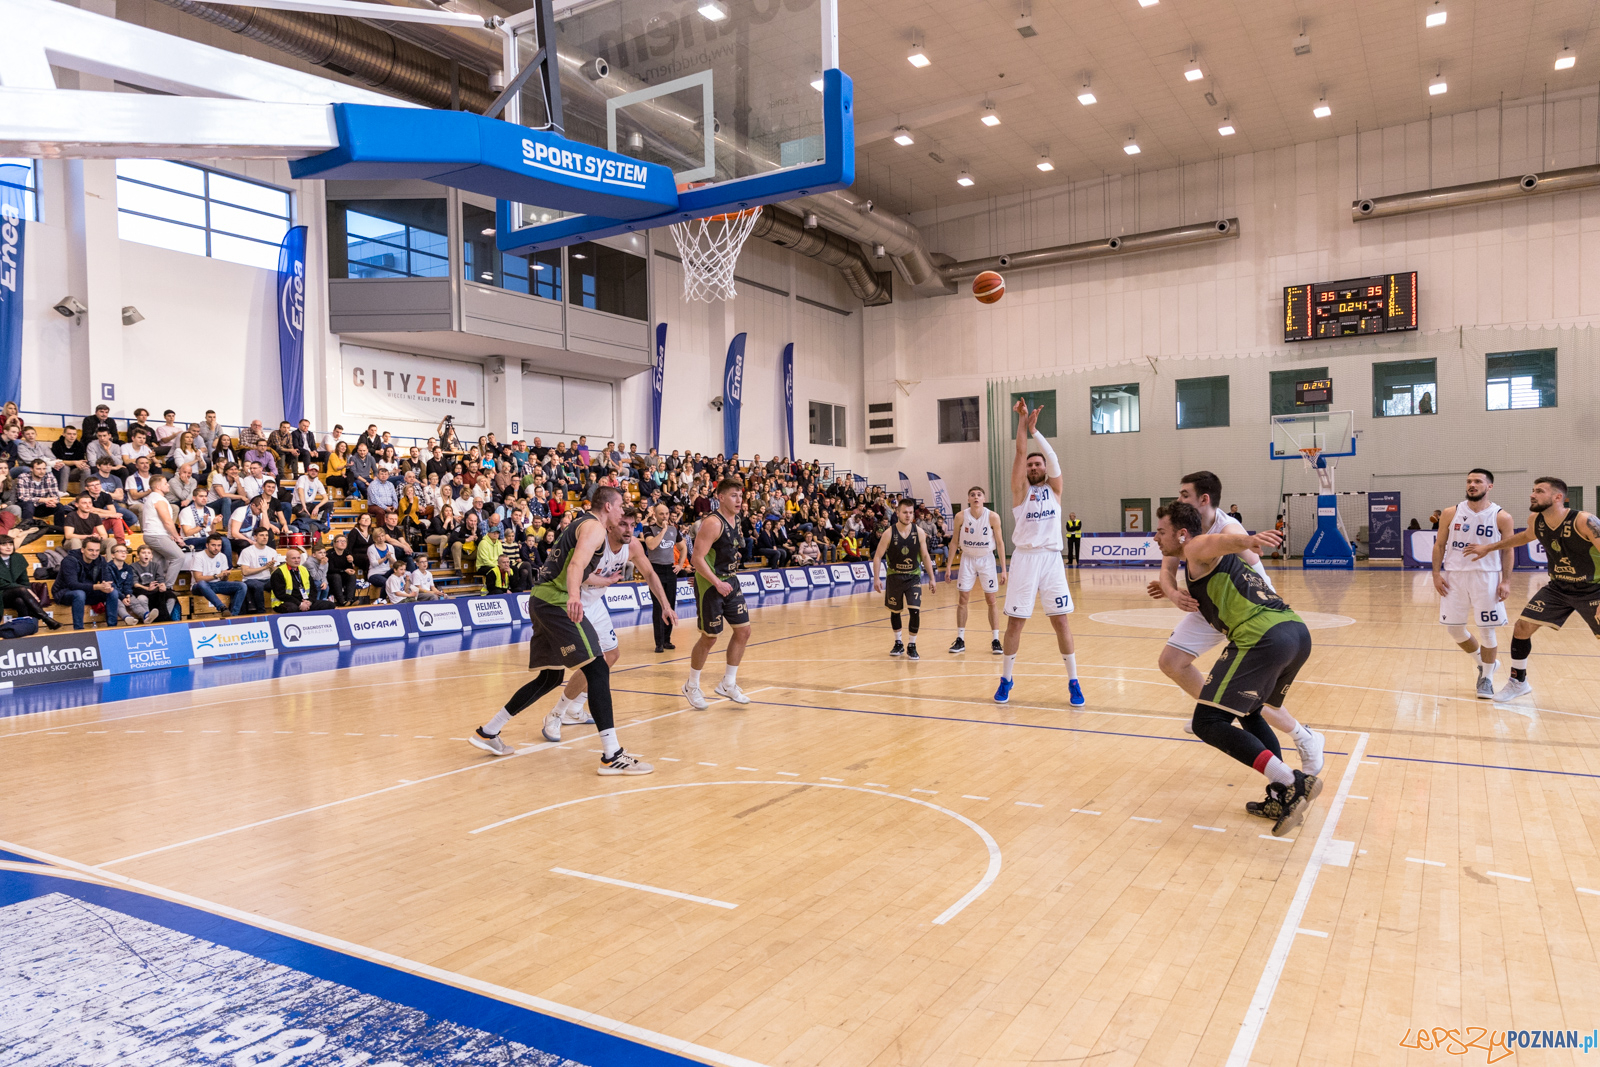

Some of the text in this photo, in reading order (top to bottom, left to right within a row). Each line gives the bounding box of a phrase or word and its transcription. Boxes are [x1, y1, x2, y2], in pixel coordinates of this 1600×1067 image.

[522, 138, 648, 183] SPORT SYSTEM
[0, 206, 20, 293] Enea
[291, 259, 304, 331] Enea
[1321, 291, 1335, 302] 35
[1367, 286, 1382, 297] 35
[655, 345, 665, 393] Enea
[353, 367, 457, 398] CITYZEN
[731, 354, 743, 401] Enea
[104, 386, 112, 398] C
[512, 423, 518, 433] B
[1026, 509, 1055, 519] BIOARM
[1130, 514, 1138, 529] 2
[983, 527, 988, 535] 2
[1476, 525, 1493, 537] 66
[912, 536, 917, 544] 7
[989, 580, 994, 588] 2
[608, 594, 633, 602] BIOFARM
[1055, 595, 1068, 608] 97
[475, 601, 502, 611] HELMEX
[737, 604, 748, 615] 24
[477, 610, 503, 618] EXHIBITIONS
[1481, 610, 1498, 622] 66
[353, 620, 398, 631] BIOFARM
[217, 630, 269, 643] funclub
[0, 645, 98, 669] drukma
[128, 650, 171, 664] HOTEL
[1, 660, 99, 678] DRUKARNIA SKOCZYŃSKI
[130, 660, 171, 670] POZNAŃSKI
